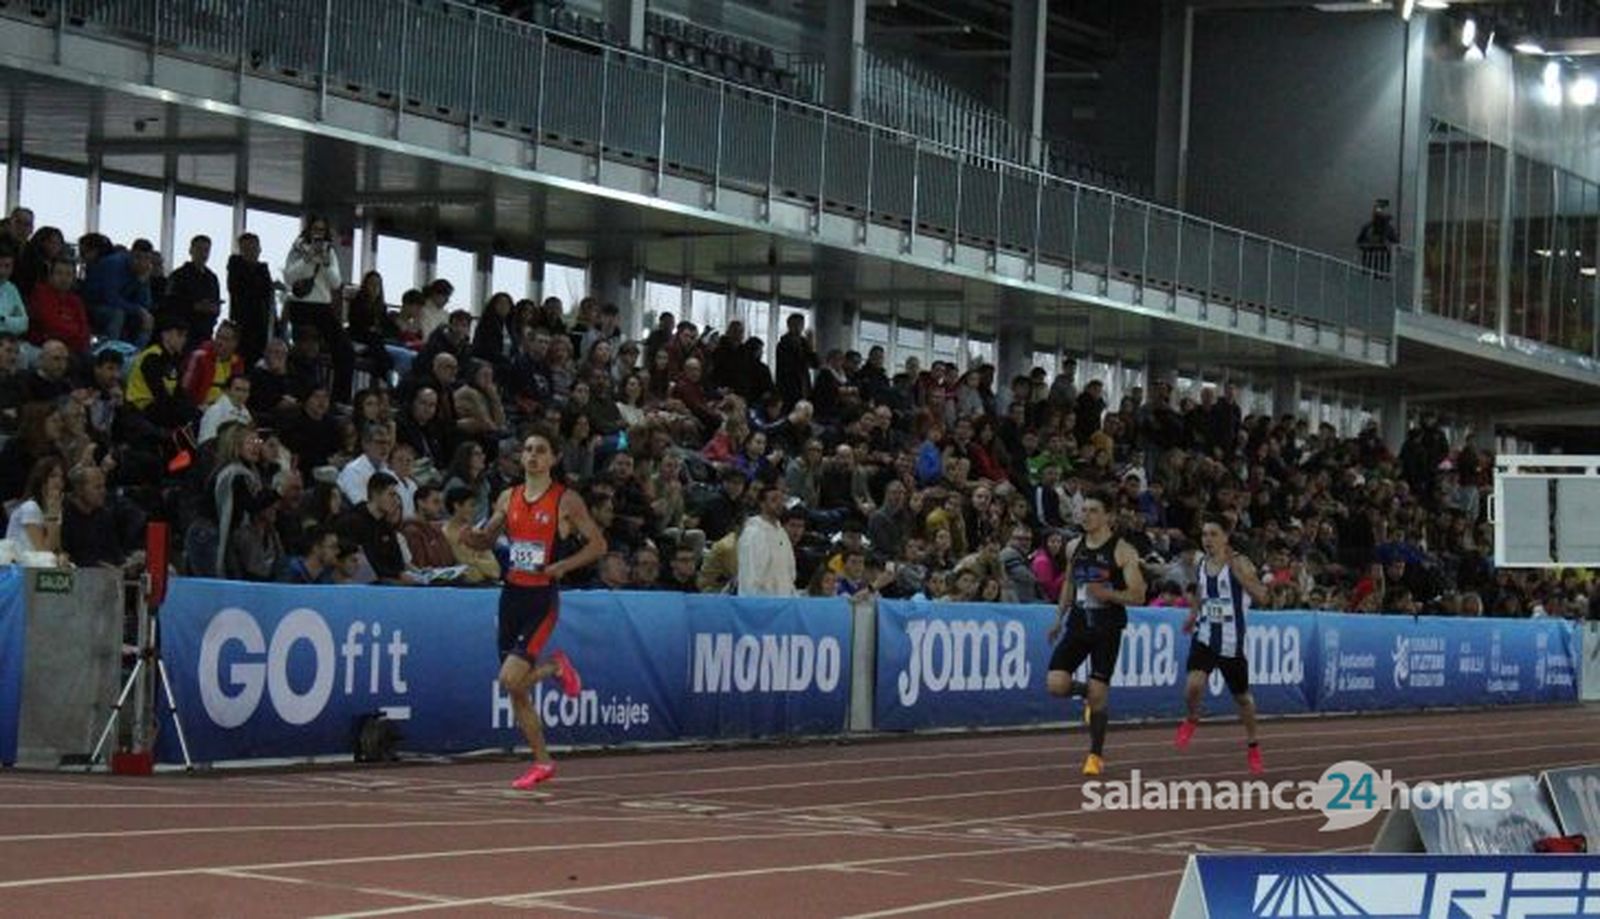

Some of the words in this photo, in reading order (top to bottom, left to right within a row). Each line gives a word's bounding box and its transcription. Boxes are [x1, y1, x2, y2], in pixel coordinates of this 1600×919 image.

[198, 608, 335, 728] GO
[342, 620, 409, 695] fit
[694, 632, 841, 693] MONDO
[601, 696, 650, 731] viajes
[1428, 872, 1600, 919] RE
